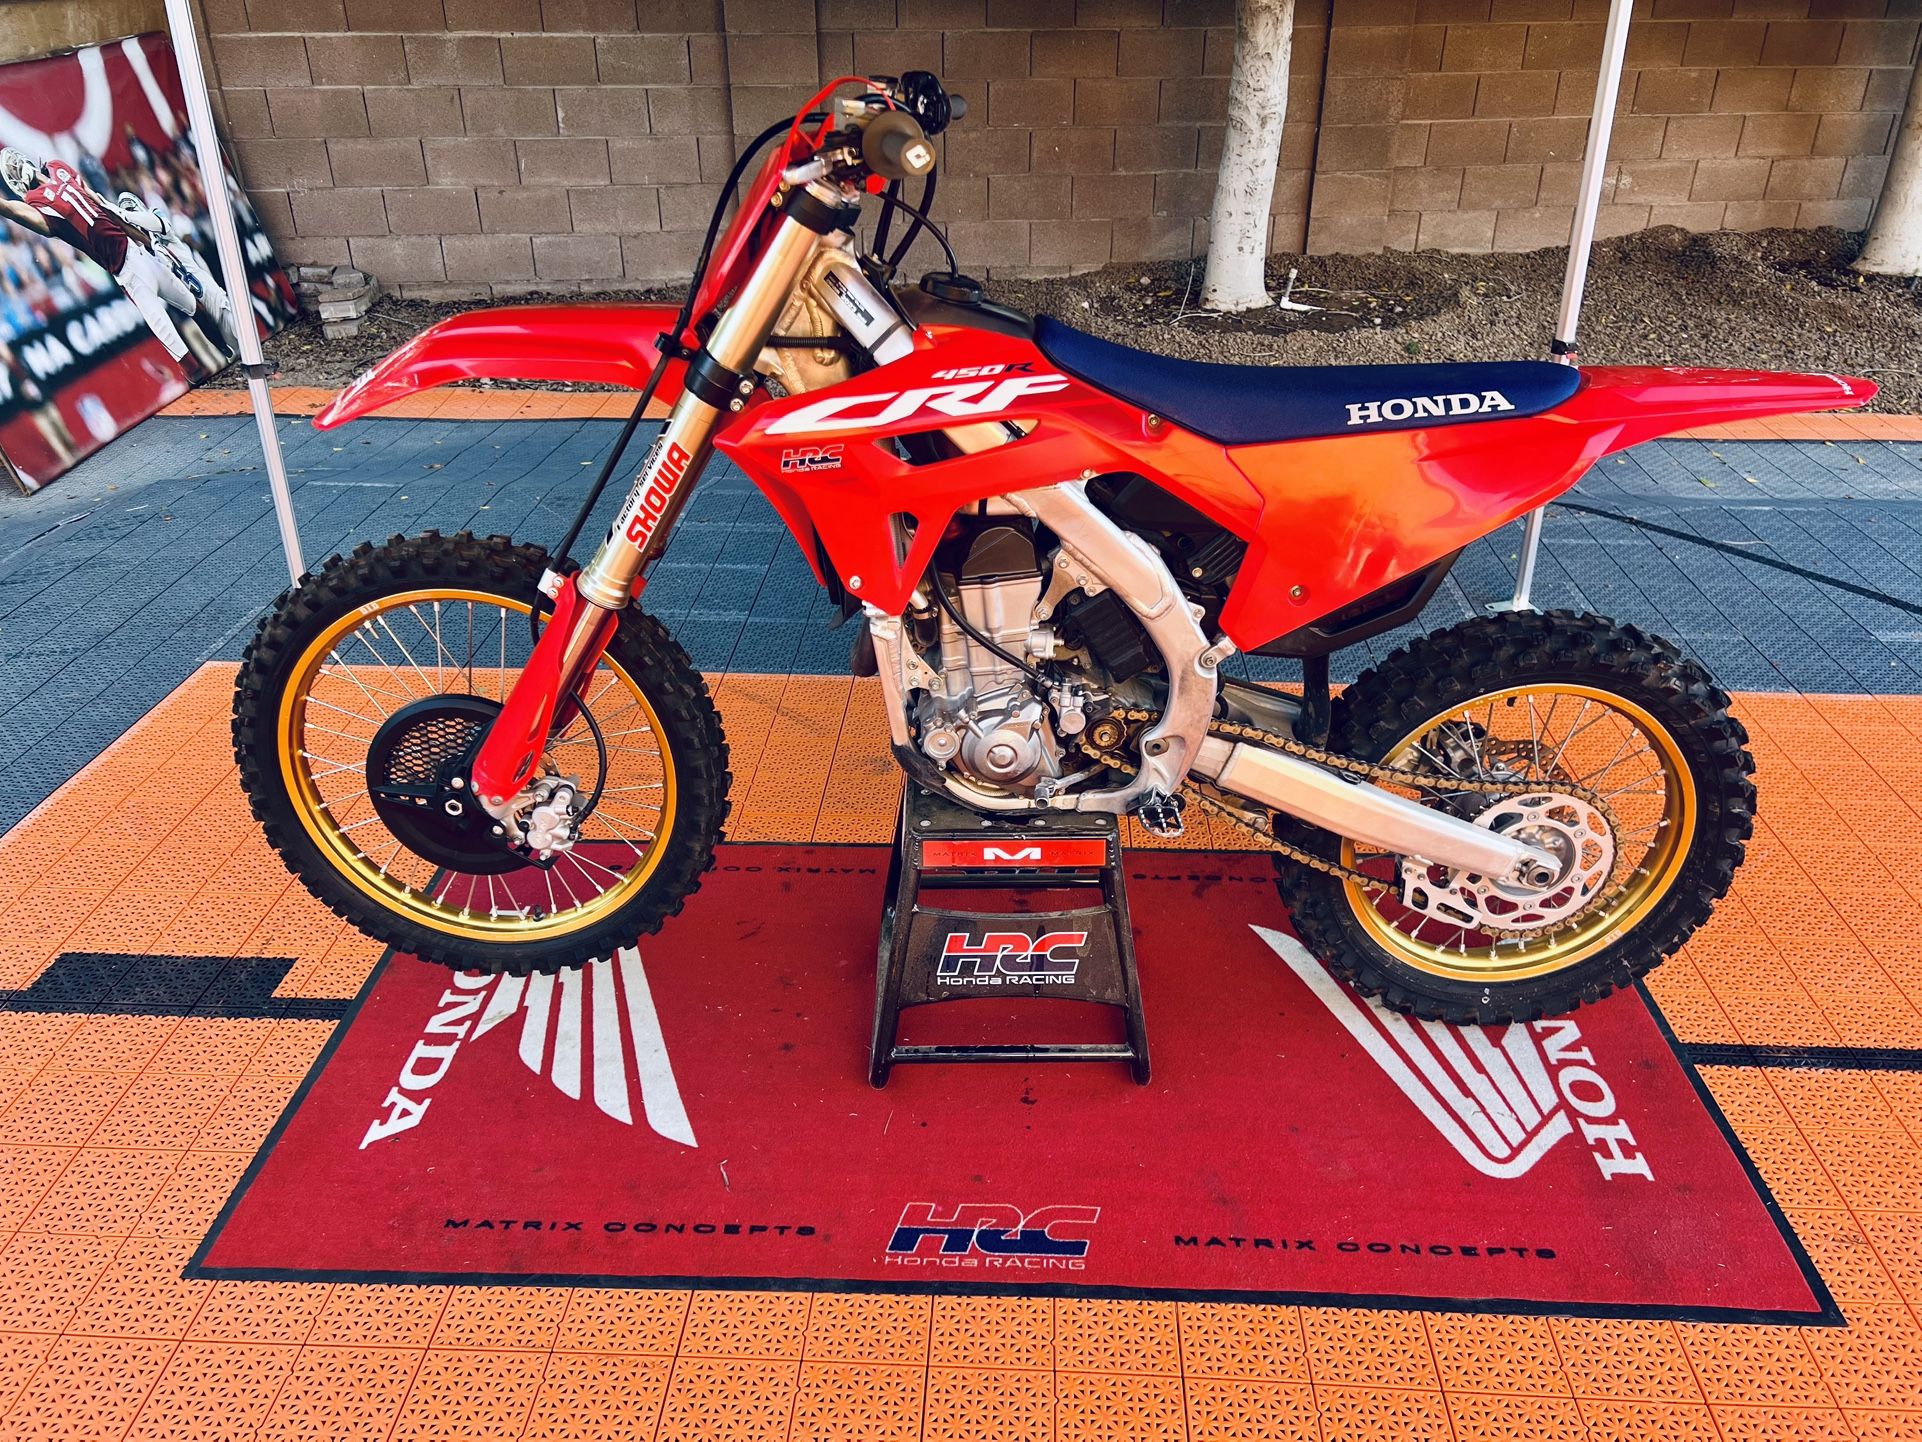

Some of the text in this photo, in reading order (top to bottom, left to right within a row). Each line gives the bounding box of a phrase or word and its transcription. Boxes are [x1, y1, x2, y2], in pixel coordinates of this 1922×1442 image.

[61, 184, 98, 227] 11
[764, 373, 1070, 435] CRF
[1345, 389, 1515, 426] HONDA
[781, 443, 844, 469] HRC
[626, 441, 693, 552] SHOWA
[936, 932, 1088, 976] HRC
[937, 975, 1075, 985] Honda RACING
[358, 970, 496, 1150] NDA
[1532, 1020, 1655, 1182] HON
[443, 1218, 816, 1236] MATRIX CONCEPTS
[885, 1202, 1101, 1257] HRC
[1174, 1235, 1557, 1259] MATRIX CONCEPTS
[884, 1256, 1086, 1270] Honda RACING
